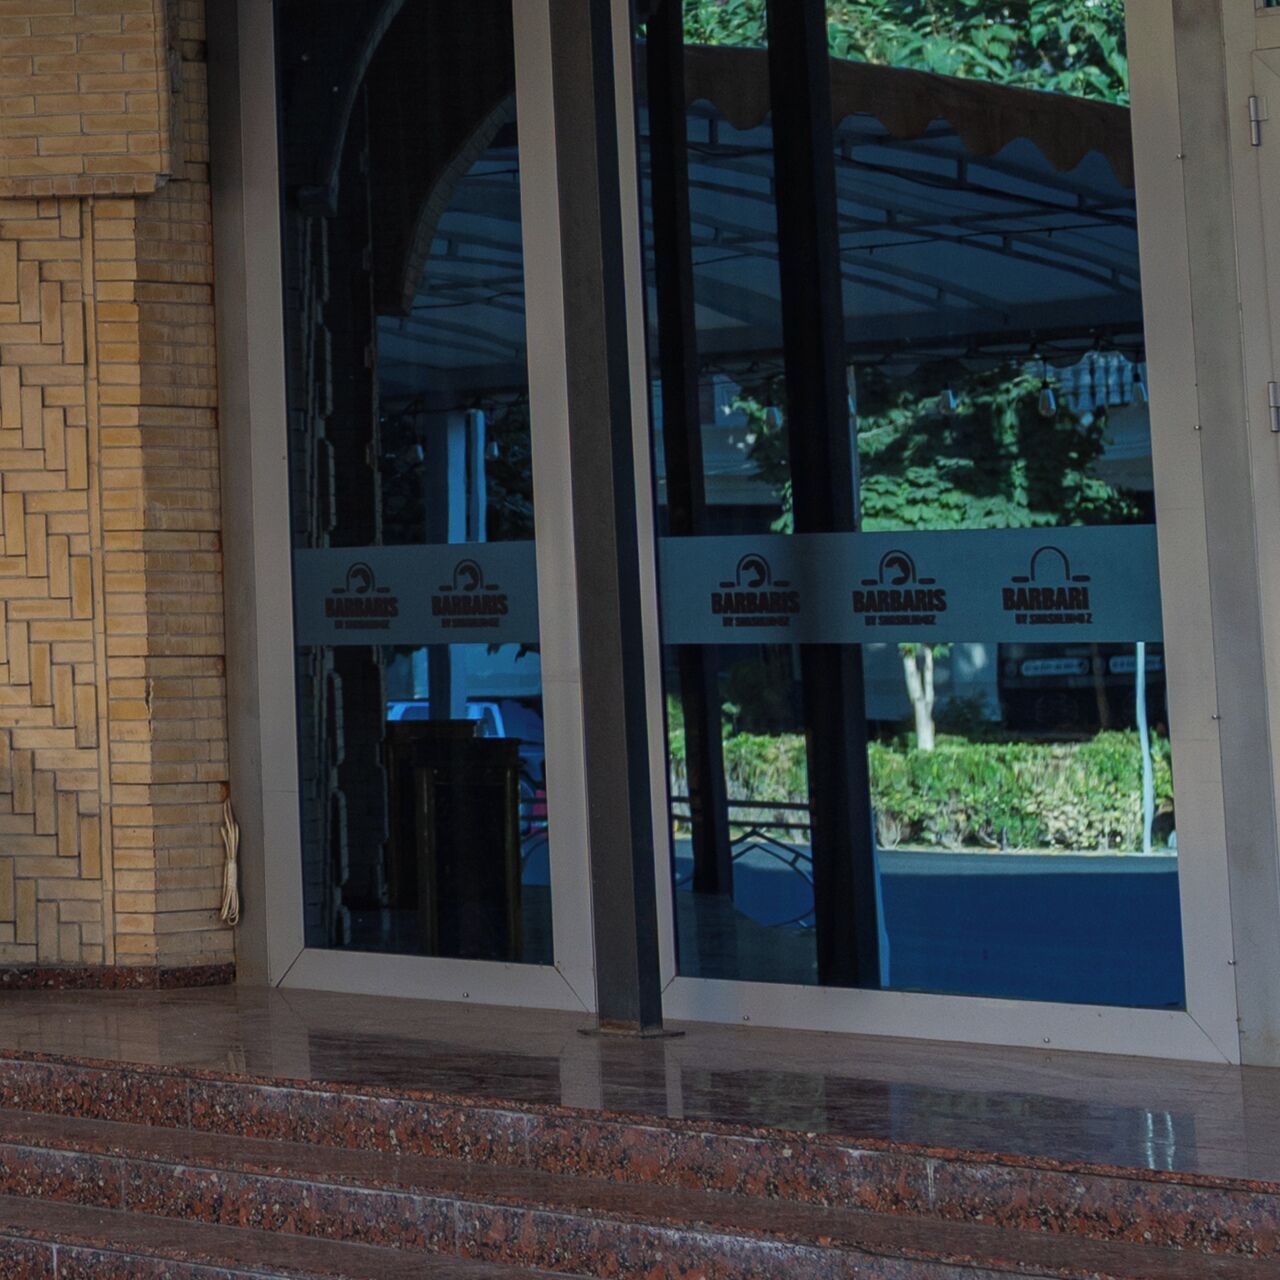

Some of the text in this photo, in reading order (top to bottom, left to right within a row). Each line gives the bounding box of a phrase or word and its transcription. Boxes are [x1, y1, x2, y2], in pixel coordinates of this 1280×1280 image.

[432, 594, 509, 616] BARBARIS
[711, 590, 801, 614] BARBARIS
[852, 588, 947, 613] BARBARIS
[1002, 586, 1090, 611] BARBARI
